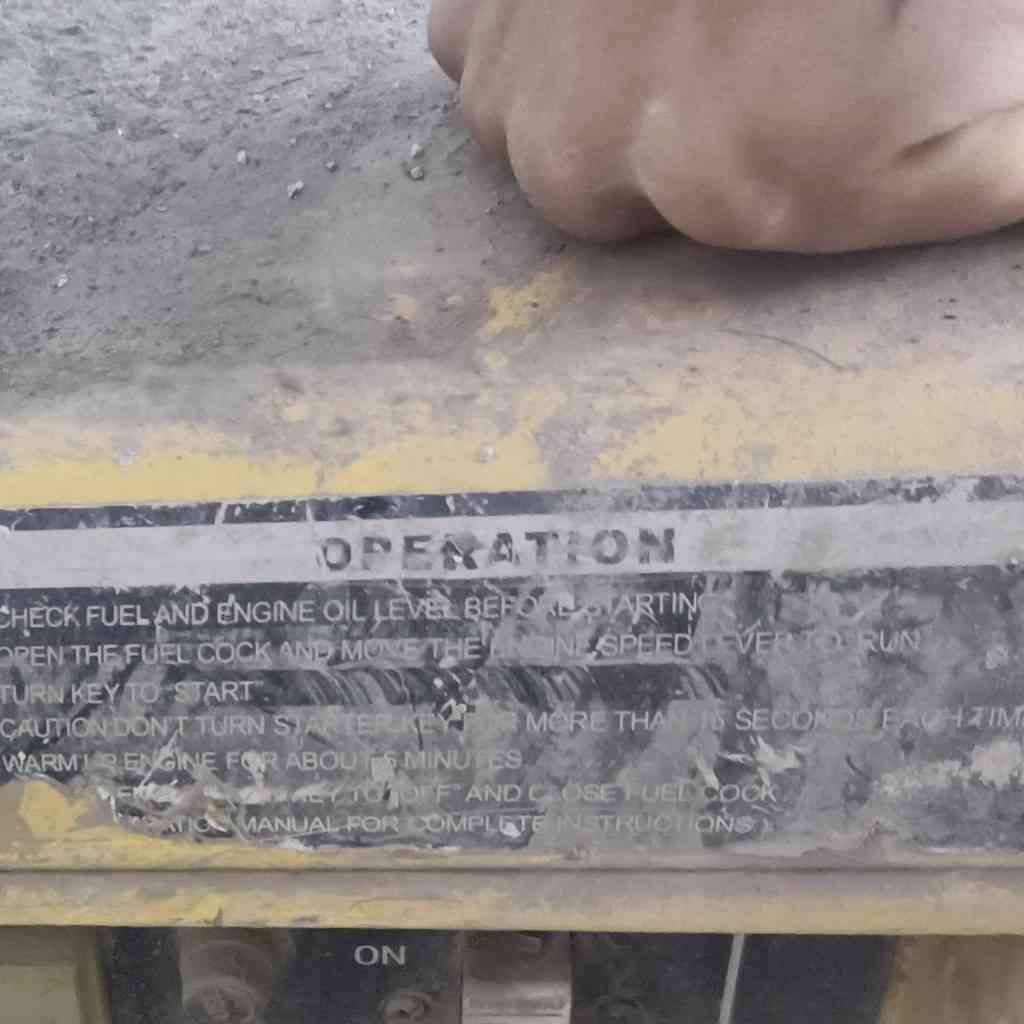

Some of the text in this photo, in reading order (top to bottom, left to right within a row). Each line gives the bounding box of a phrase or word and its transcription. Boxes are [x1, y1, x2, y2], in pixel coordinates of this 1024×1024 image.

[86, 604, 149, 627] FUEL
[156, 603, 209, 626] AND
[217, 598, 316, 625] ENGINE
[323, 598, 366, 622] OIL
[374, 597, 460, 622] LEVEL
[71, 645, 120, 666] THE
[126, 644, 190, 666] FUEL
[197, 642, 272, 664] COCK
[279, 641, 332, 663] AND
[429, 636, 482, 660] THE
[596, 632, 693, 656] SPEED
[71, 682, 120, 705] KEY
[126, 682, 161, 702] TO
[0, 718, 108, 739] CAUTION
[197, 716, 265, 737] TURN
[526, 710, 608, 733] MORE
[125, 751, 217, 772] ENGINE
[465, 782, 520, 802] AND
[243, 814, 337, 833] MANUAL
[347, 814, 399, 833] FOR
[354, 945, 406, 966] ON
